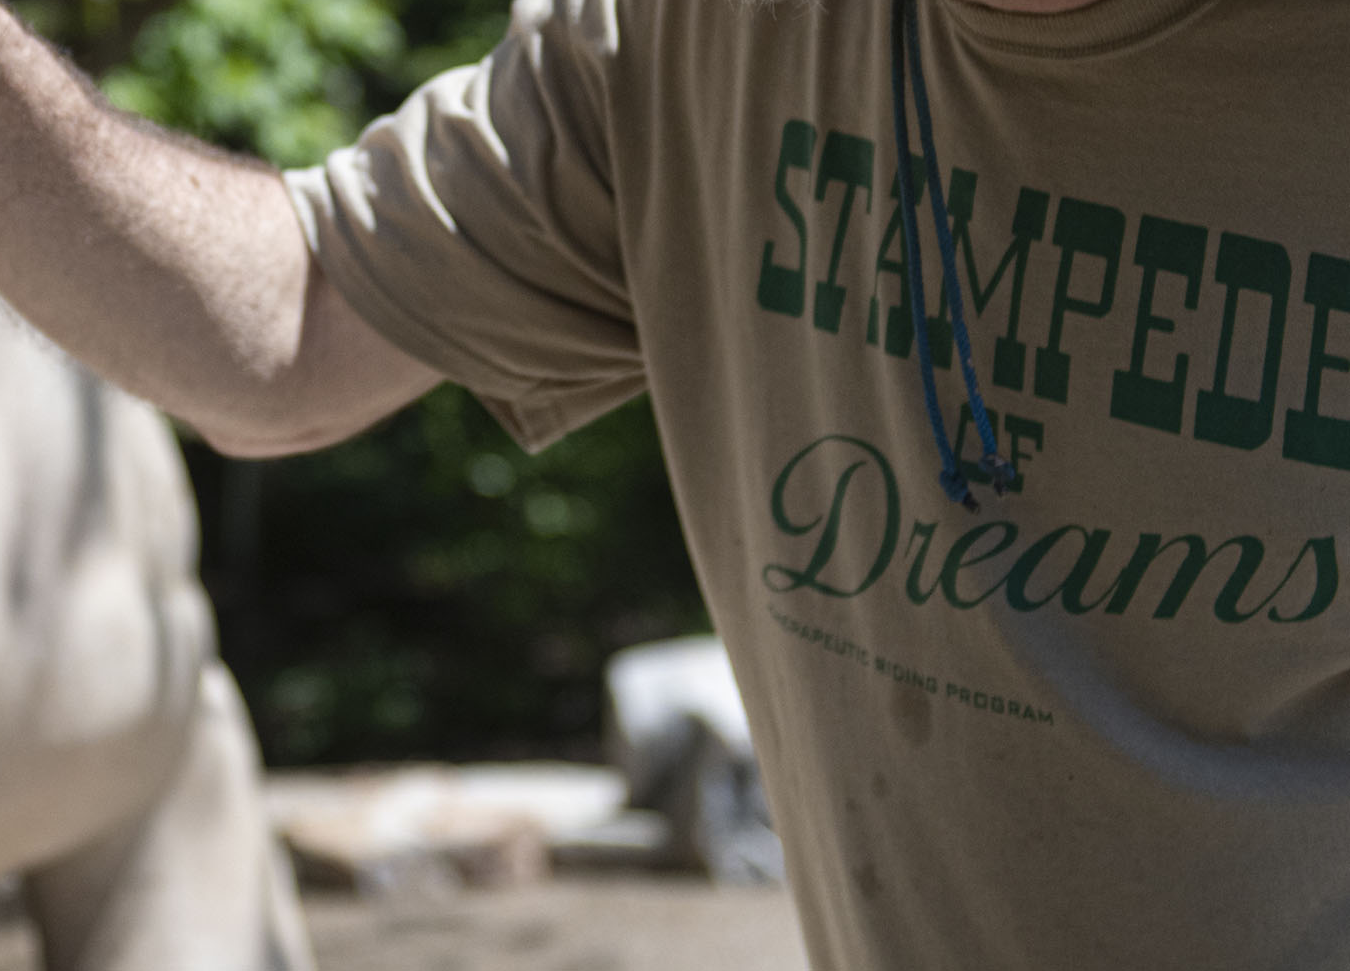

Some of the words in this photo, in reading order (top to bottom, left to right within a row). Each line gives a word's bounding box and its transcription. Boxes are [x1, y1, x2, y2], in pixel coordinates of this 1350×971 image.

[757, 119, 1350, 471] STAMPEDE
[952, 402, 1043, 494] OF
[762, 434, 1339, 624] Dreams
[767, 602, 869, 666] RAPEUTIC
[874, 655, 938, 694] RIDING
[946, 682, 1054, 726] PROGRAM
